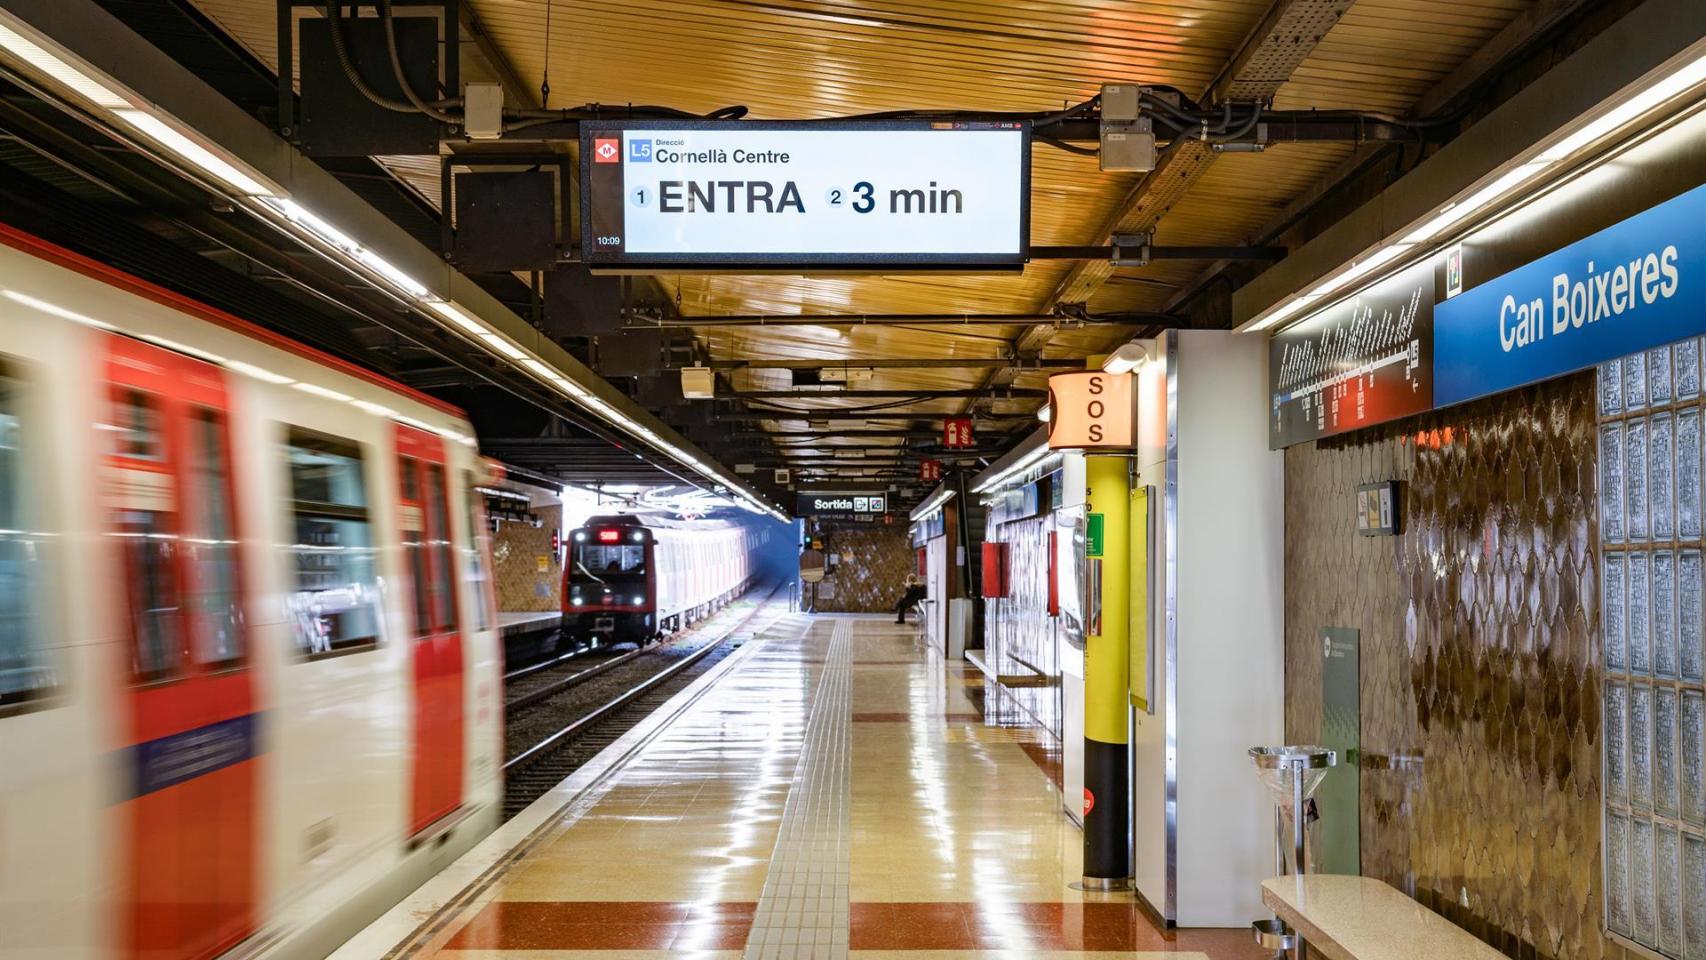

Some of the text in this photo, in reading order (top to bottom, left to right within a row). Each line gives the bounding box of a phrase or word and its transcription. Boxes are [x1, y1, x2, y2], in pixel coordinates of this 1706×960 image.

[631, 143, 651, 158] L5
[656, 149, 790, 163] Cornellà Centre
[636, 181, 963, 214] 1 ENTRA 2 3 min
[597, 237, 620, 245] 10:09
[1500, 294, 1544, 352] Can
[1552, 245, 1679, 336] Boixeres
[1088, 376, 1104, 443] SOS
[814, 499, 853, 509] Sortida
